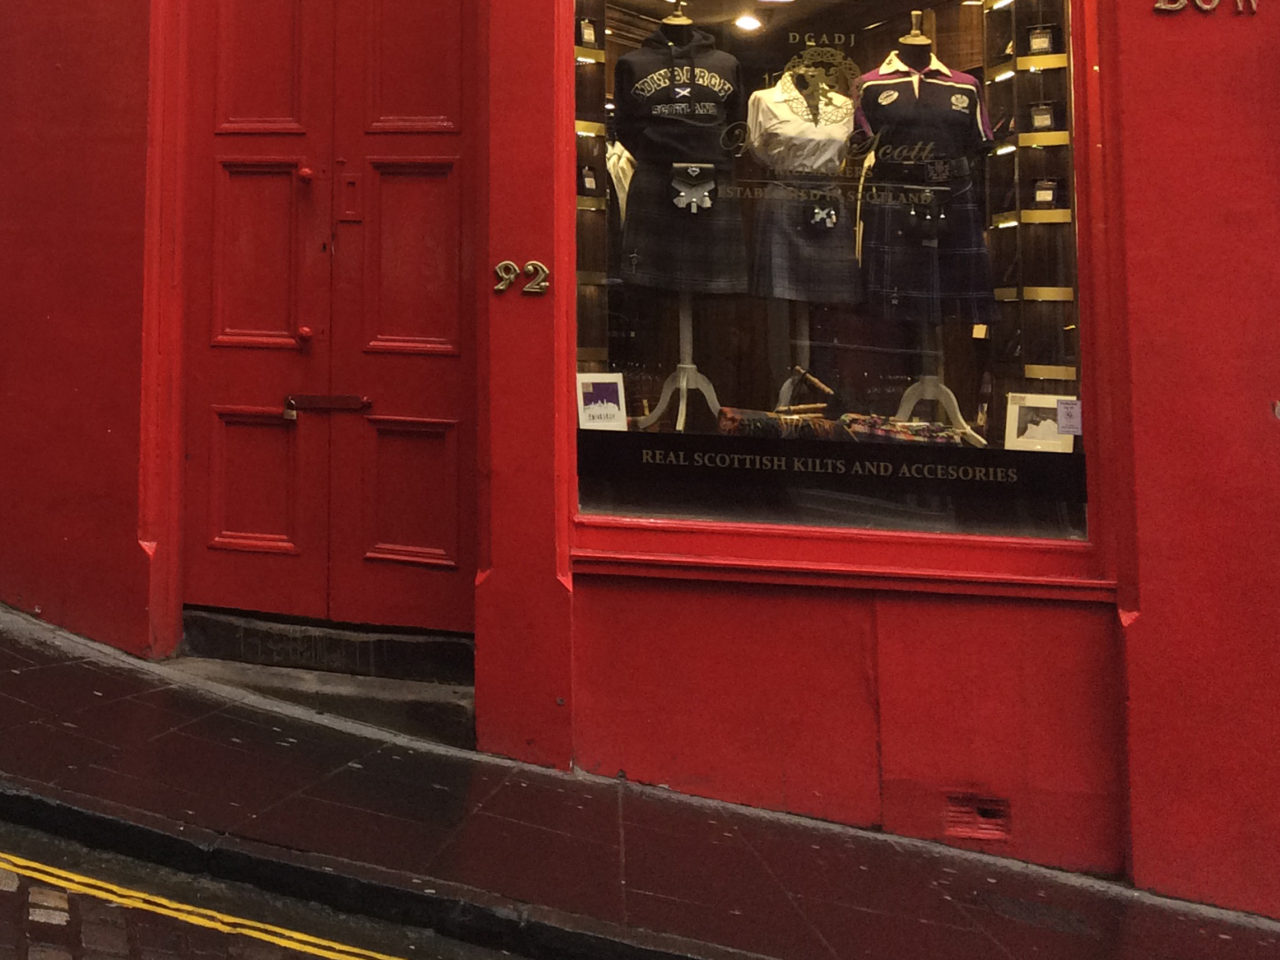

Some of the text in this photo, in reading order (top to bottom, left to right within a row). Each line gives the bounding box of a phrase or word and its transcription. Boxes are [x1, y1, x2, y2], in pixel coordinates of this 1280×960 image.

[788, 31, 857, 47] DGADJ
[494, 260, 550, 292] 92
[641, 449, 1019, 484] REAL SCOTTISH KILTS AND ACCESORIES
